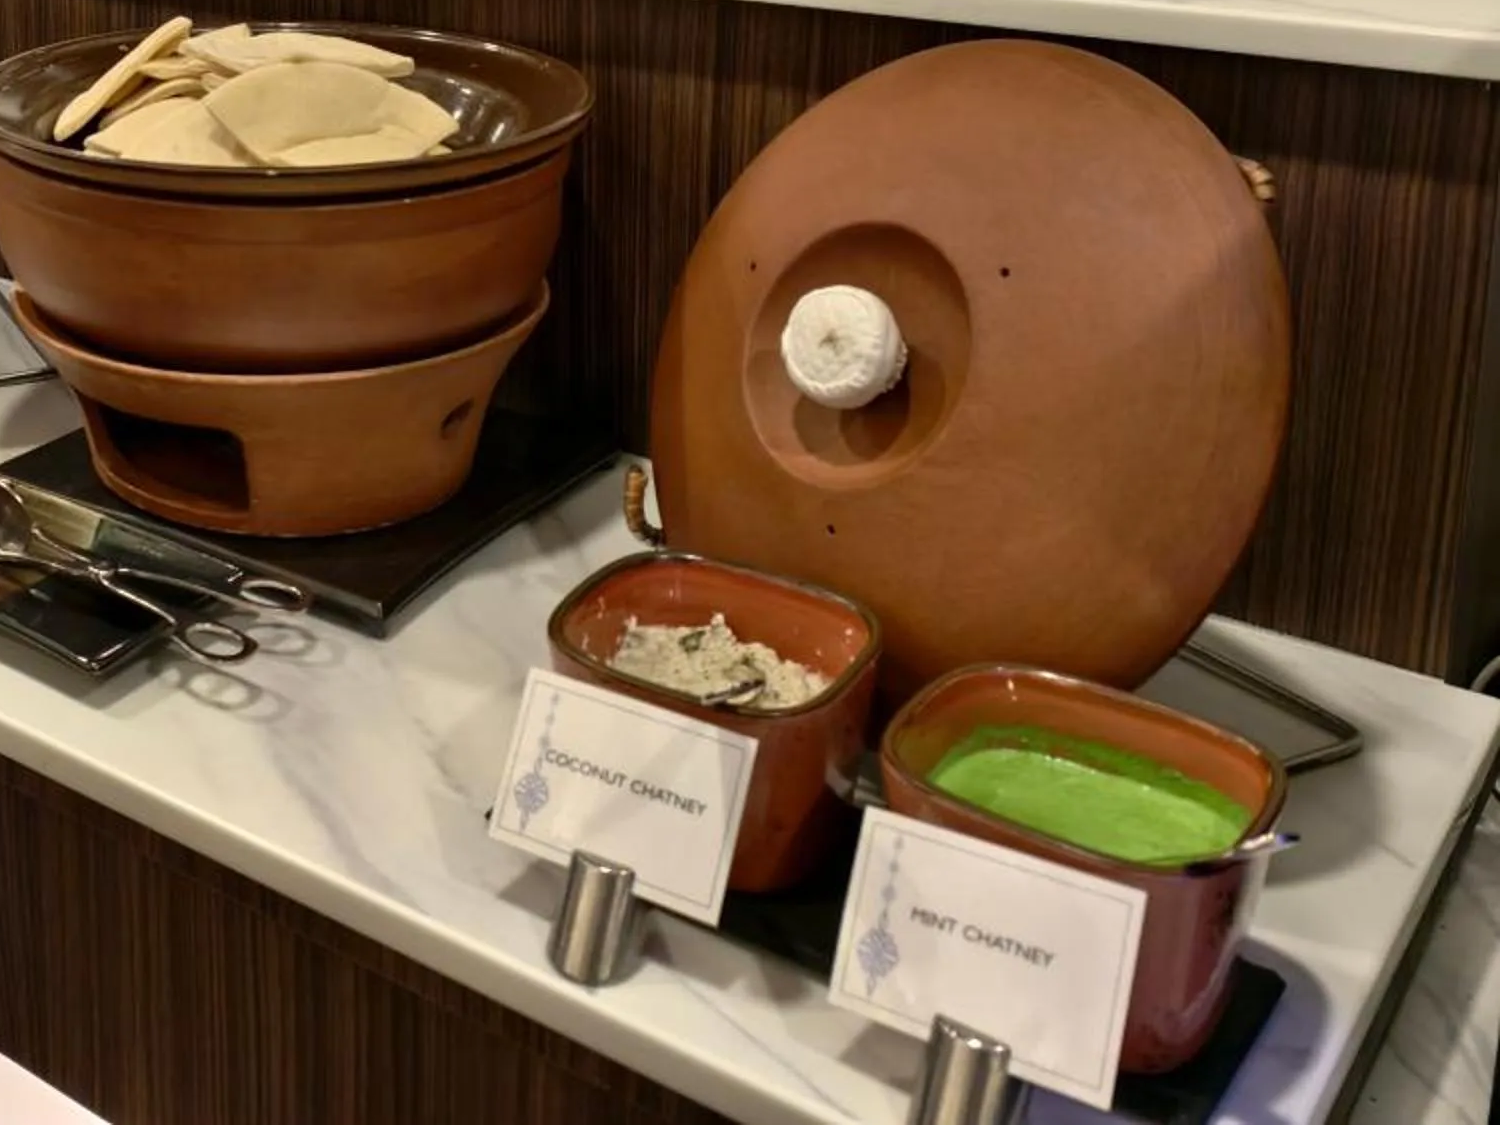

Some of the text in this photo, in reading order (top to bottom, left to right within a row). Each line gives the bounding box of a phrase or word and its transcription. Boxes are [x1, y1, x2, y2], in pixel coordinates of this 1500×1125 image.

[545, 748, 708, 817] COCONUT CHATNEY
[910, 906, 1056, 968] MINT CHATNEY
